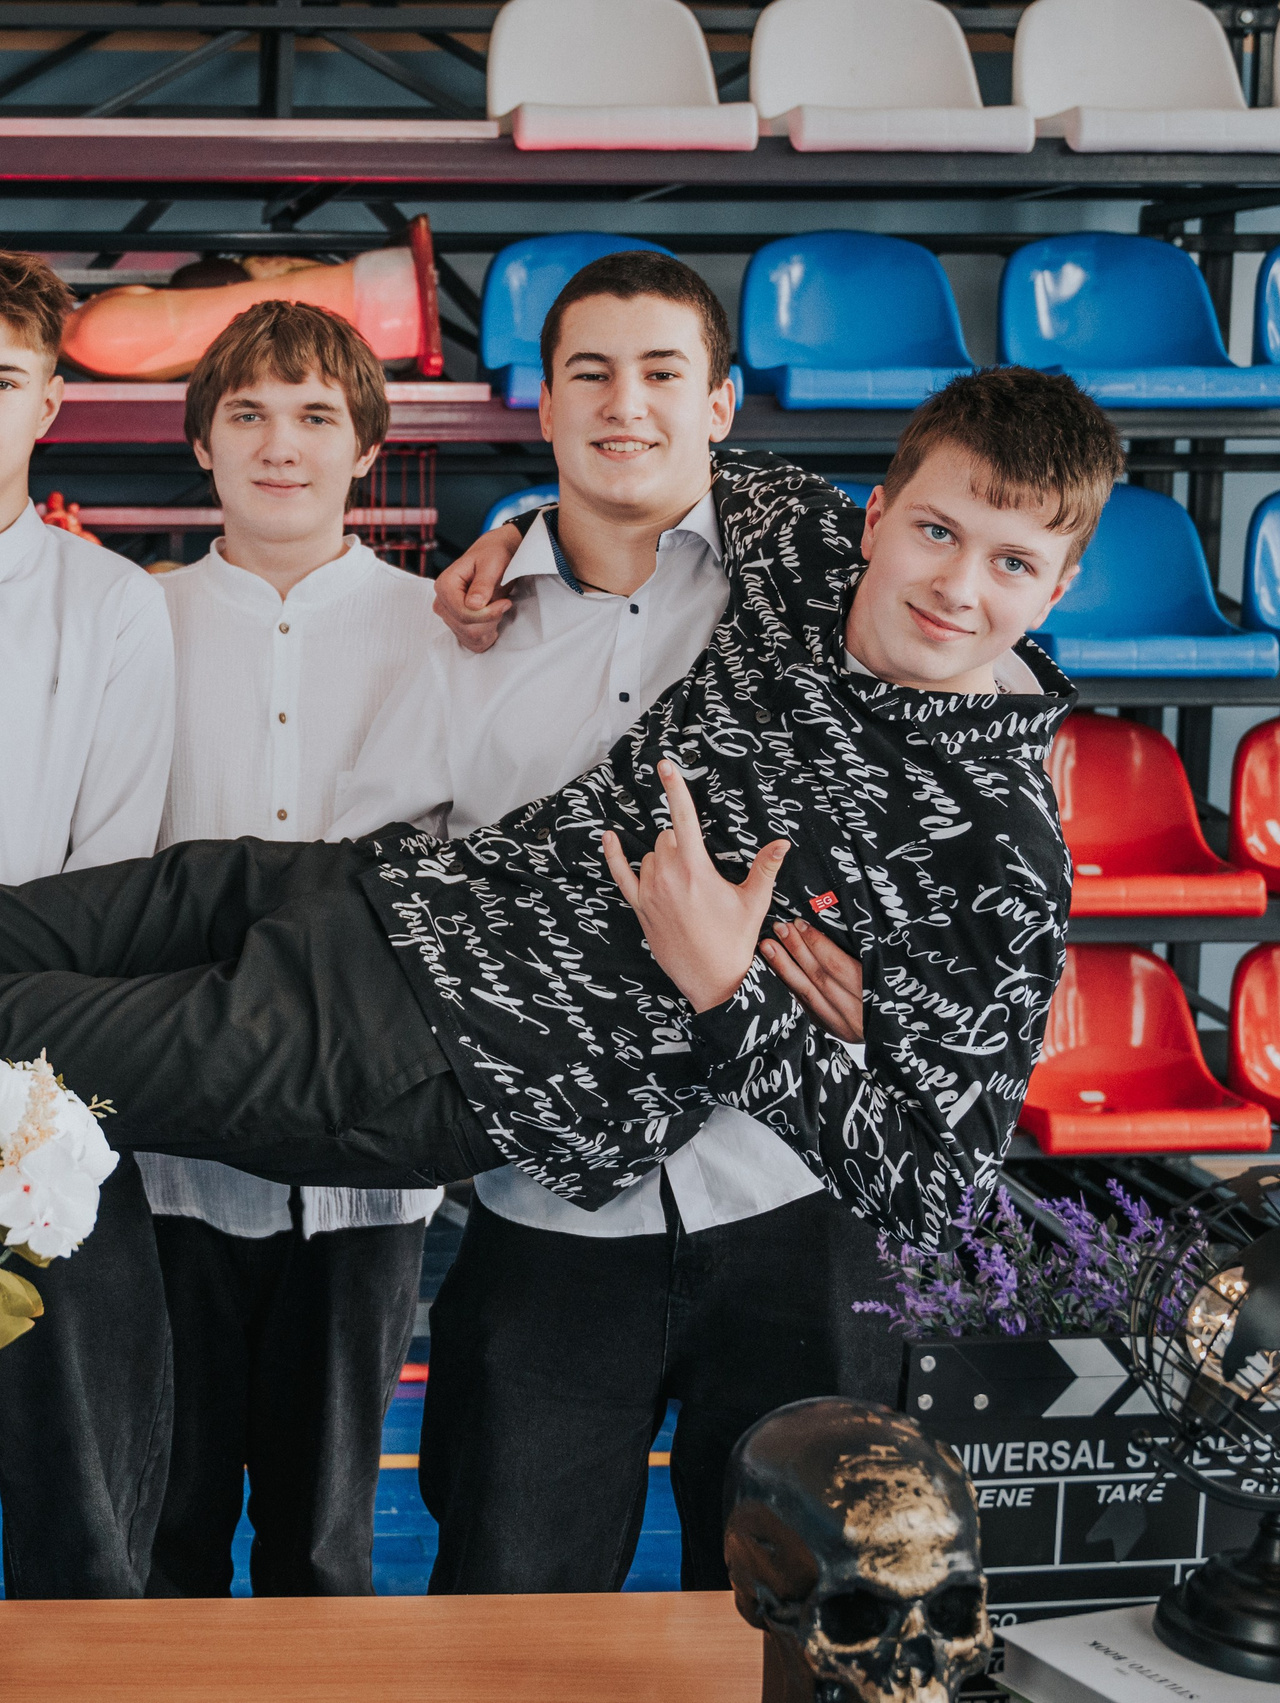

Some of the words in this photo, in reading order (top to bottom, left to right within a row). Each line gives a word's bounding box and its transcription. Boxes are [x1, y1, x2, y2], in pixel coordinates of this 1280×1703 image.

[950, 1439, 1115, 1474] NIVERSAL
[977, 1487, 1036, 1508] ENE
[1096, 1482, 1167, 1504] TAKE
